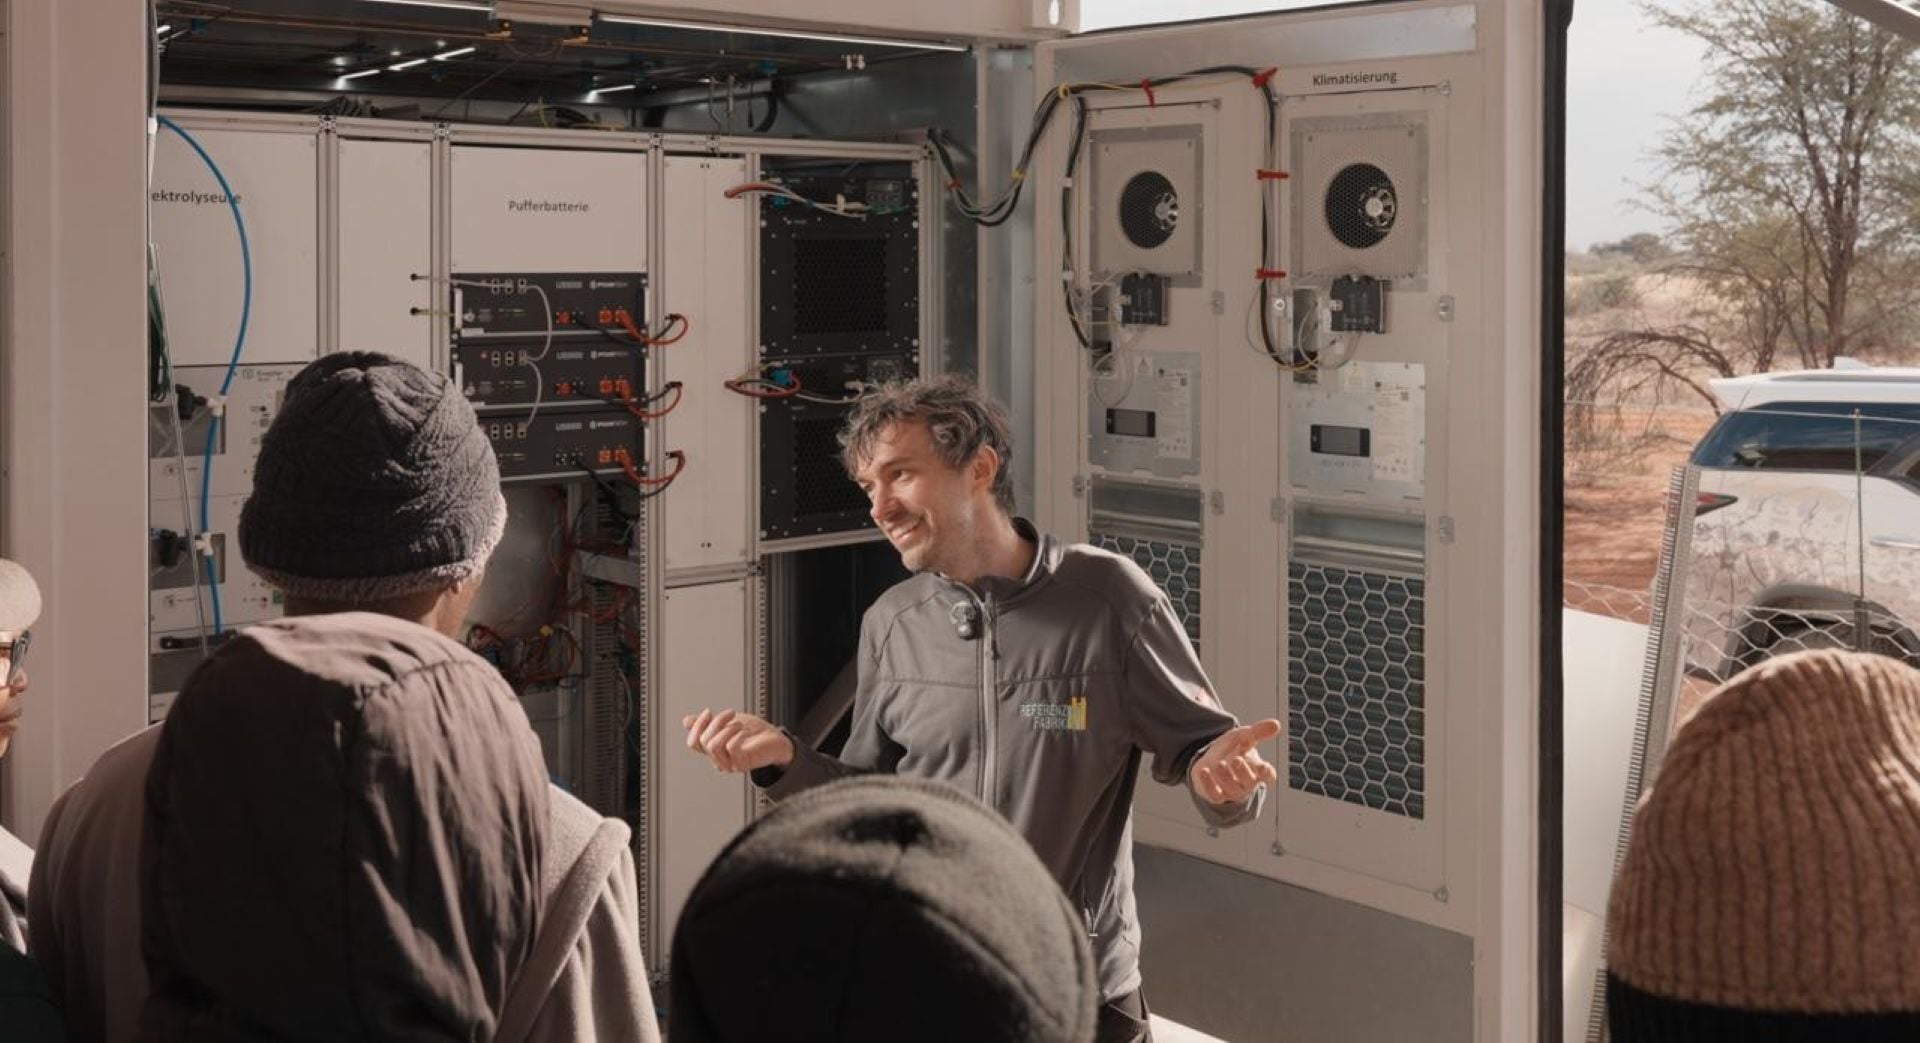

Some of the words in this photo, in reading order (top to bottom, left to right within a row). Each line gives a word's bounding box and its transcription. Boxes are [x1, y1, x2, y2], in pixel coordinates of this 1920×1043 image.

[1313, 71, 1397, 86] Klimatisierung
[151, 189, 242, 205] ektrolyseue
[508, 199, 589, 212] Pufferbatterie
